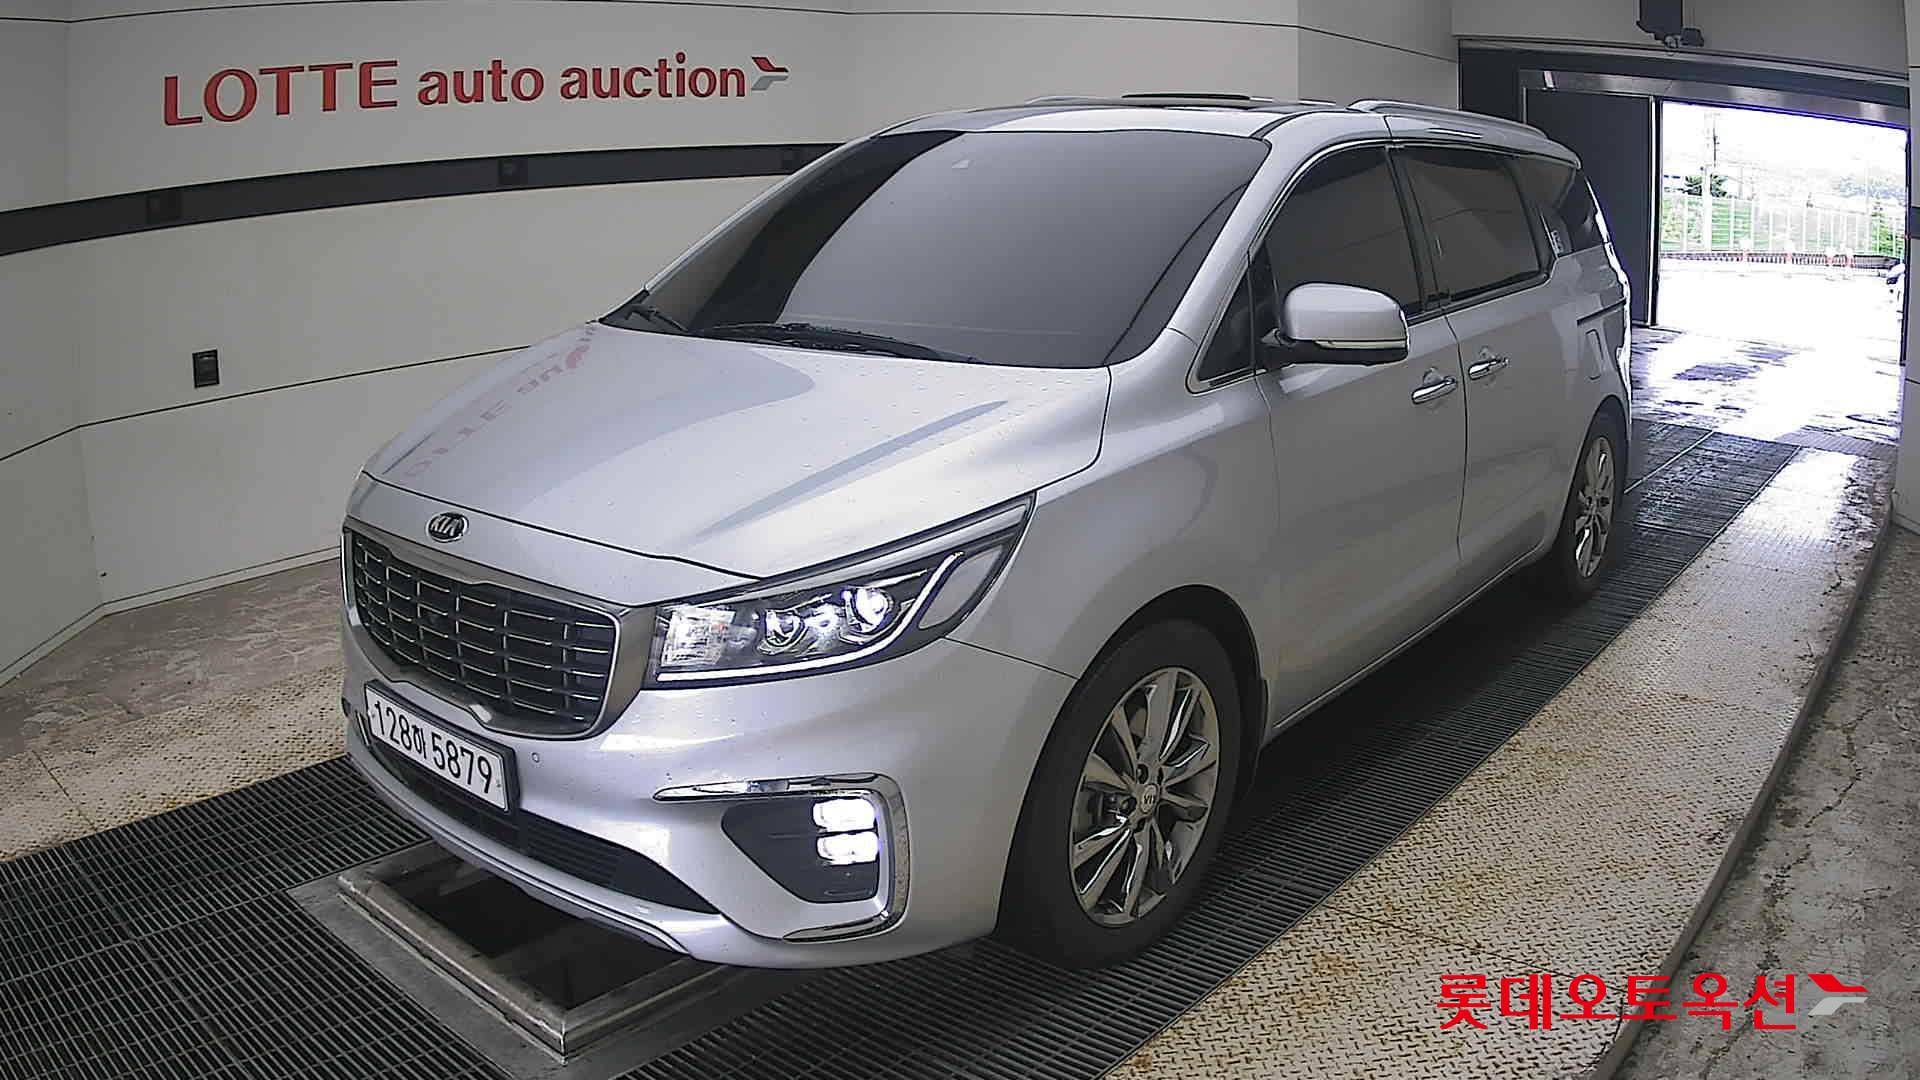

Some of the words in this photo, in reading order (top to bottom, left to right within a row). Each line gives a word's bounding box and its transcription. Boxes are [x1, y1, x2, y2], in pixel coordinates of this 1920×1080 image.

[164, 60, 398, 126] LOTTE
[418, 58, 544, 105] auto
[560, 51, 746, 99] auction
[431, 731, 493, 794] 5879
